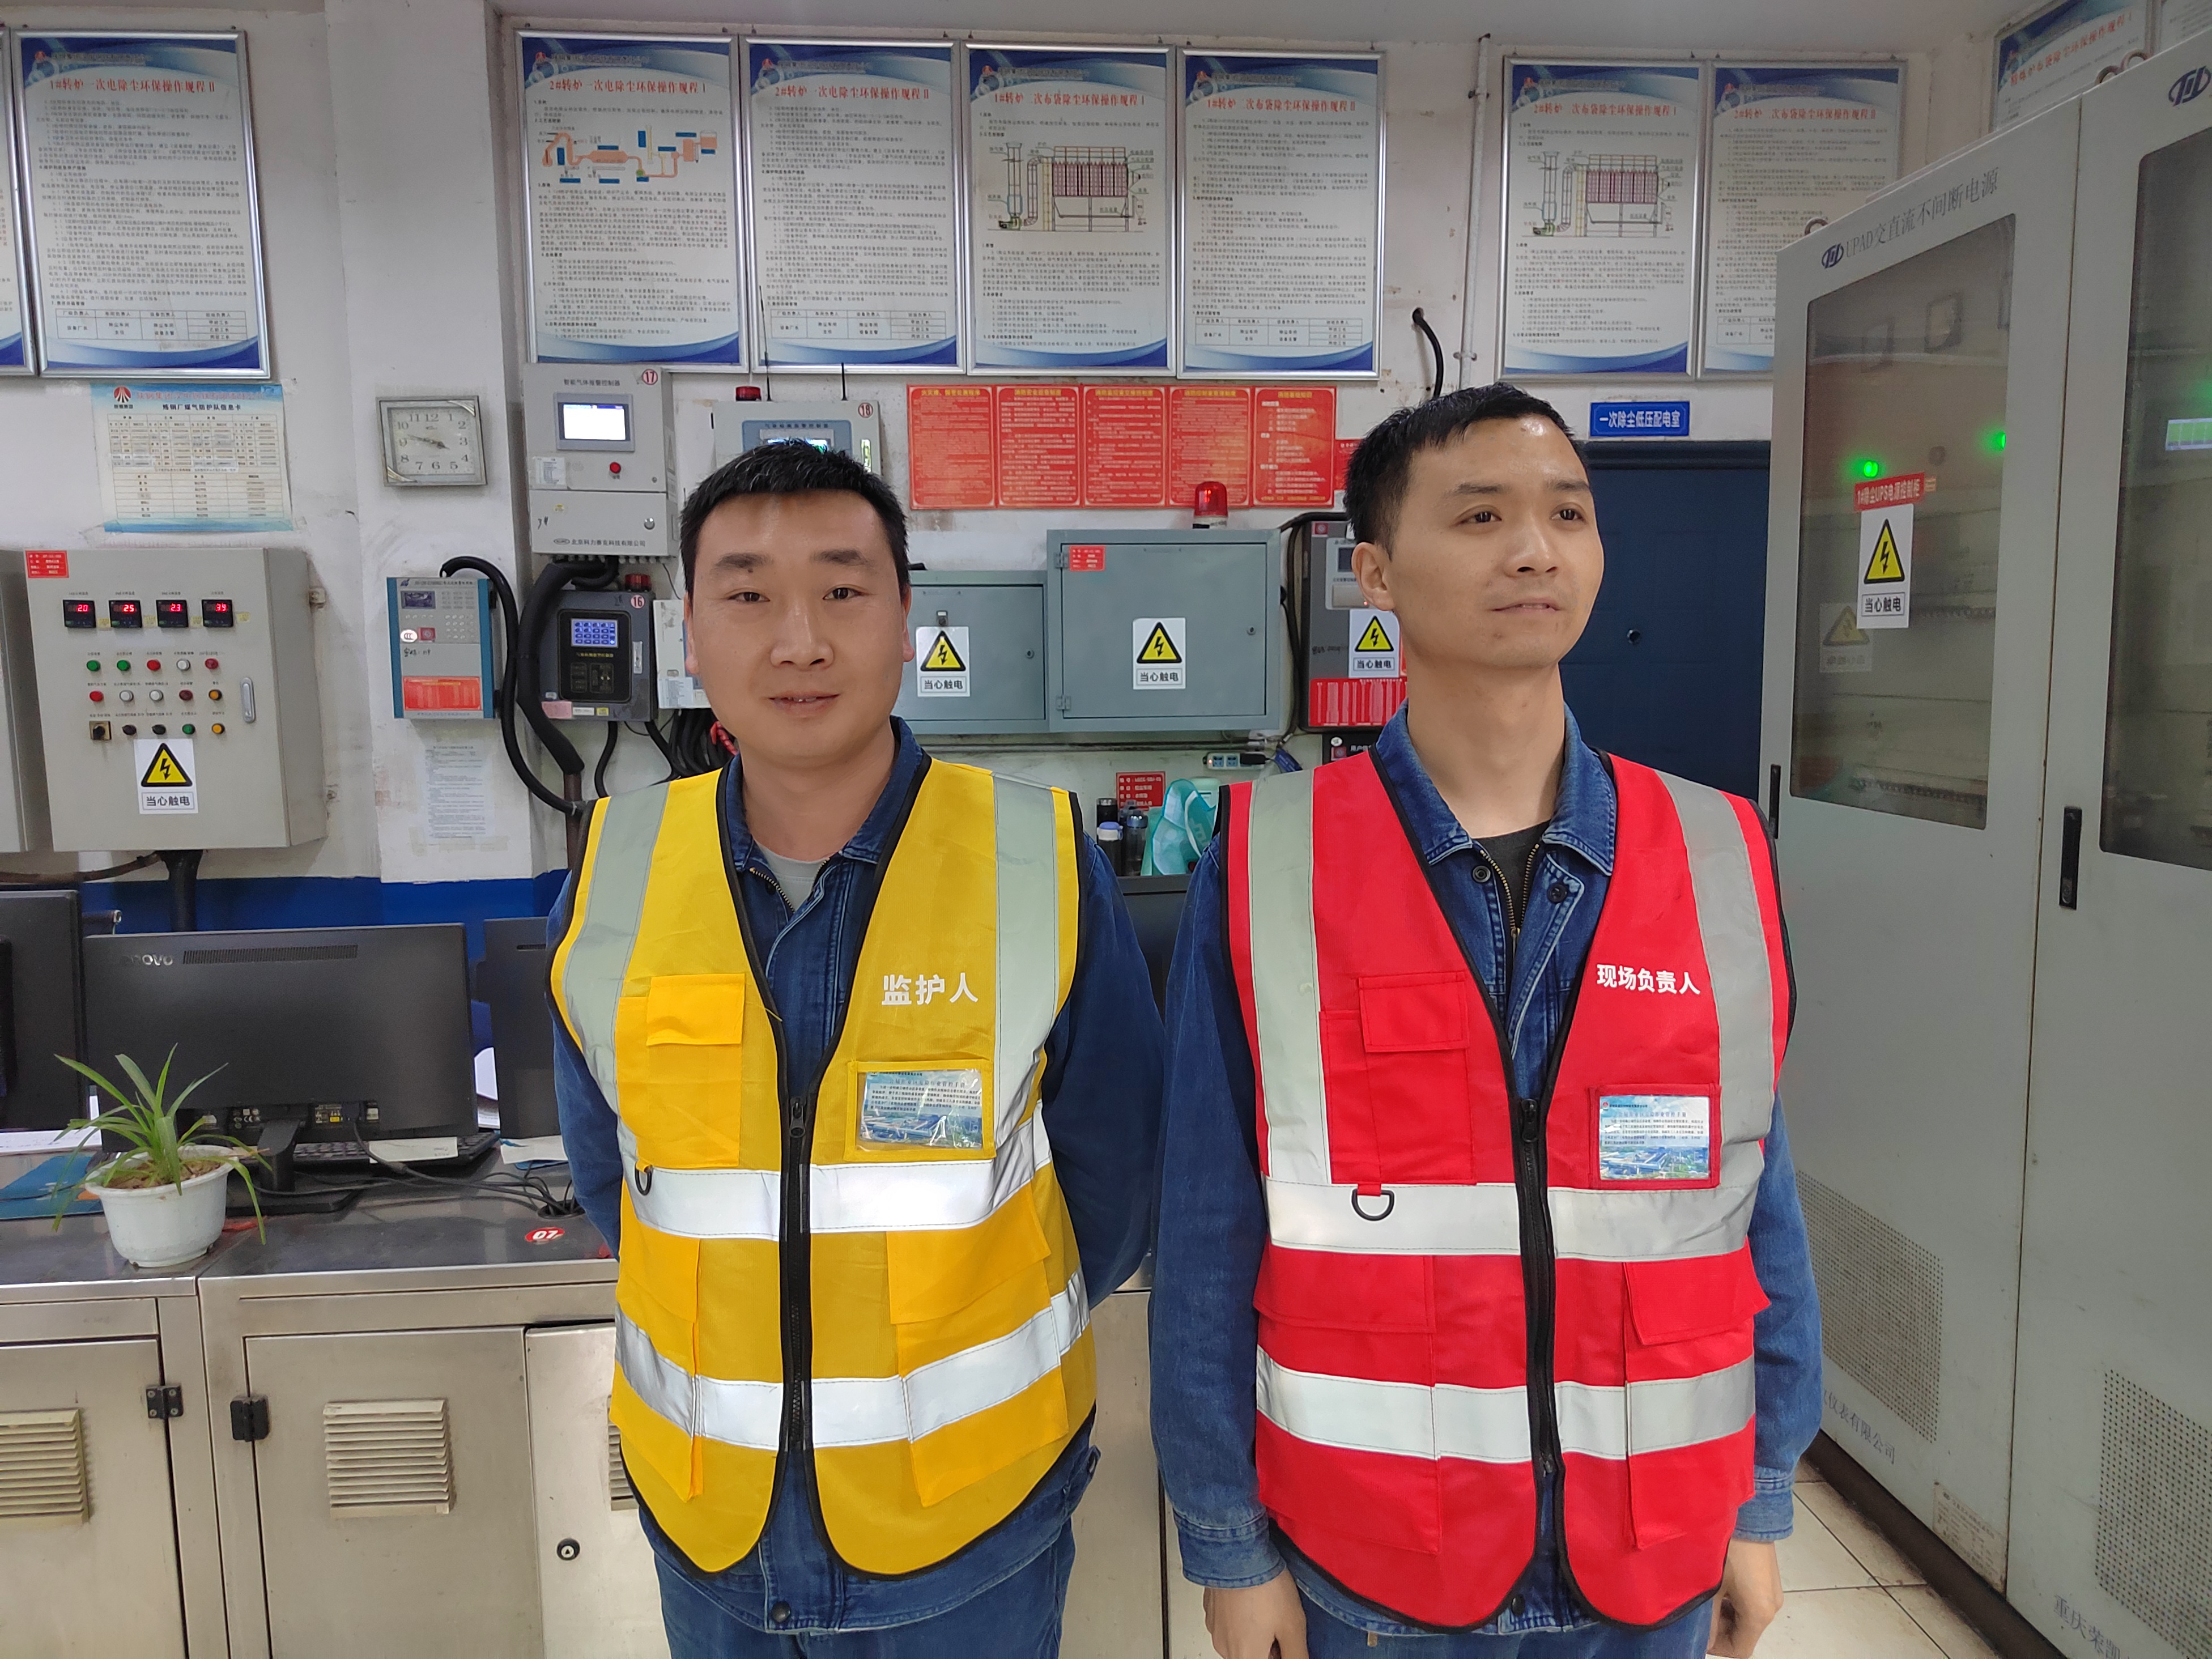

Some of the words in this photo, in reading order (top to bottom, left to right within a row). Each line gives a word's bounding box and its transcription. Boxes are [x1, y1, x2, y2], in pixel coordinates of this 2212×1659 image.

[645, 371, 655, 383] 17
[860, 404, 871, 416] 18
[426, 414, 439, 422] 12
[1600, 410, 1681, 428] 一次除尘低压配电室
[398, 421, 409, 429] 10
[458, 421, 466, 429] 2
[399, 437, 407, 446] 9
[460, 437, 468, 446] 3
[401, 454, 409, 463] 8
[415, 462, 423, 470] 7
[632, 596, 643, 607] 16
[1864, 596, 1902, 613] 当心触电
[1356, 659, 1392, 669] 当心触电
[1139, 671, 1179, 683] 当心触电
[924, 679, 963, 690] 当心触电
[146, 796, 190, 807] 当心触电
[1596, 964, 1700, 995] 现场负责人
[881, 972, 979, 1006] 监护人
[531, 1228, 559, 1241] 07
[1824, 1390, 1895, 1465] 仪表有限公司
[2053, 1594, 2130, 1659] 重庆荣凯
